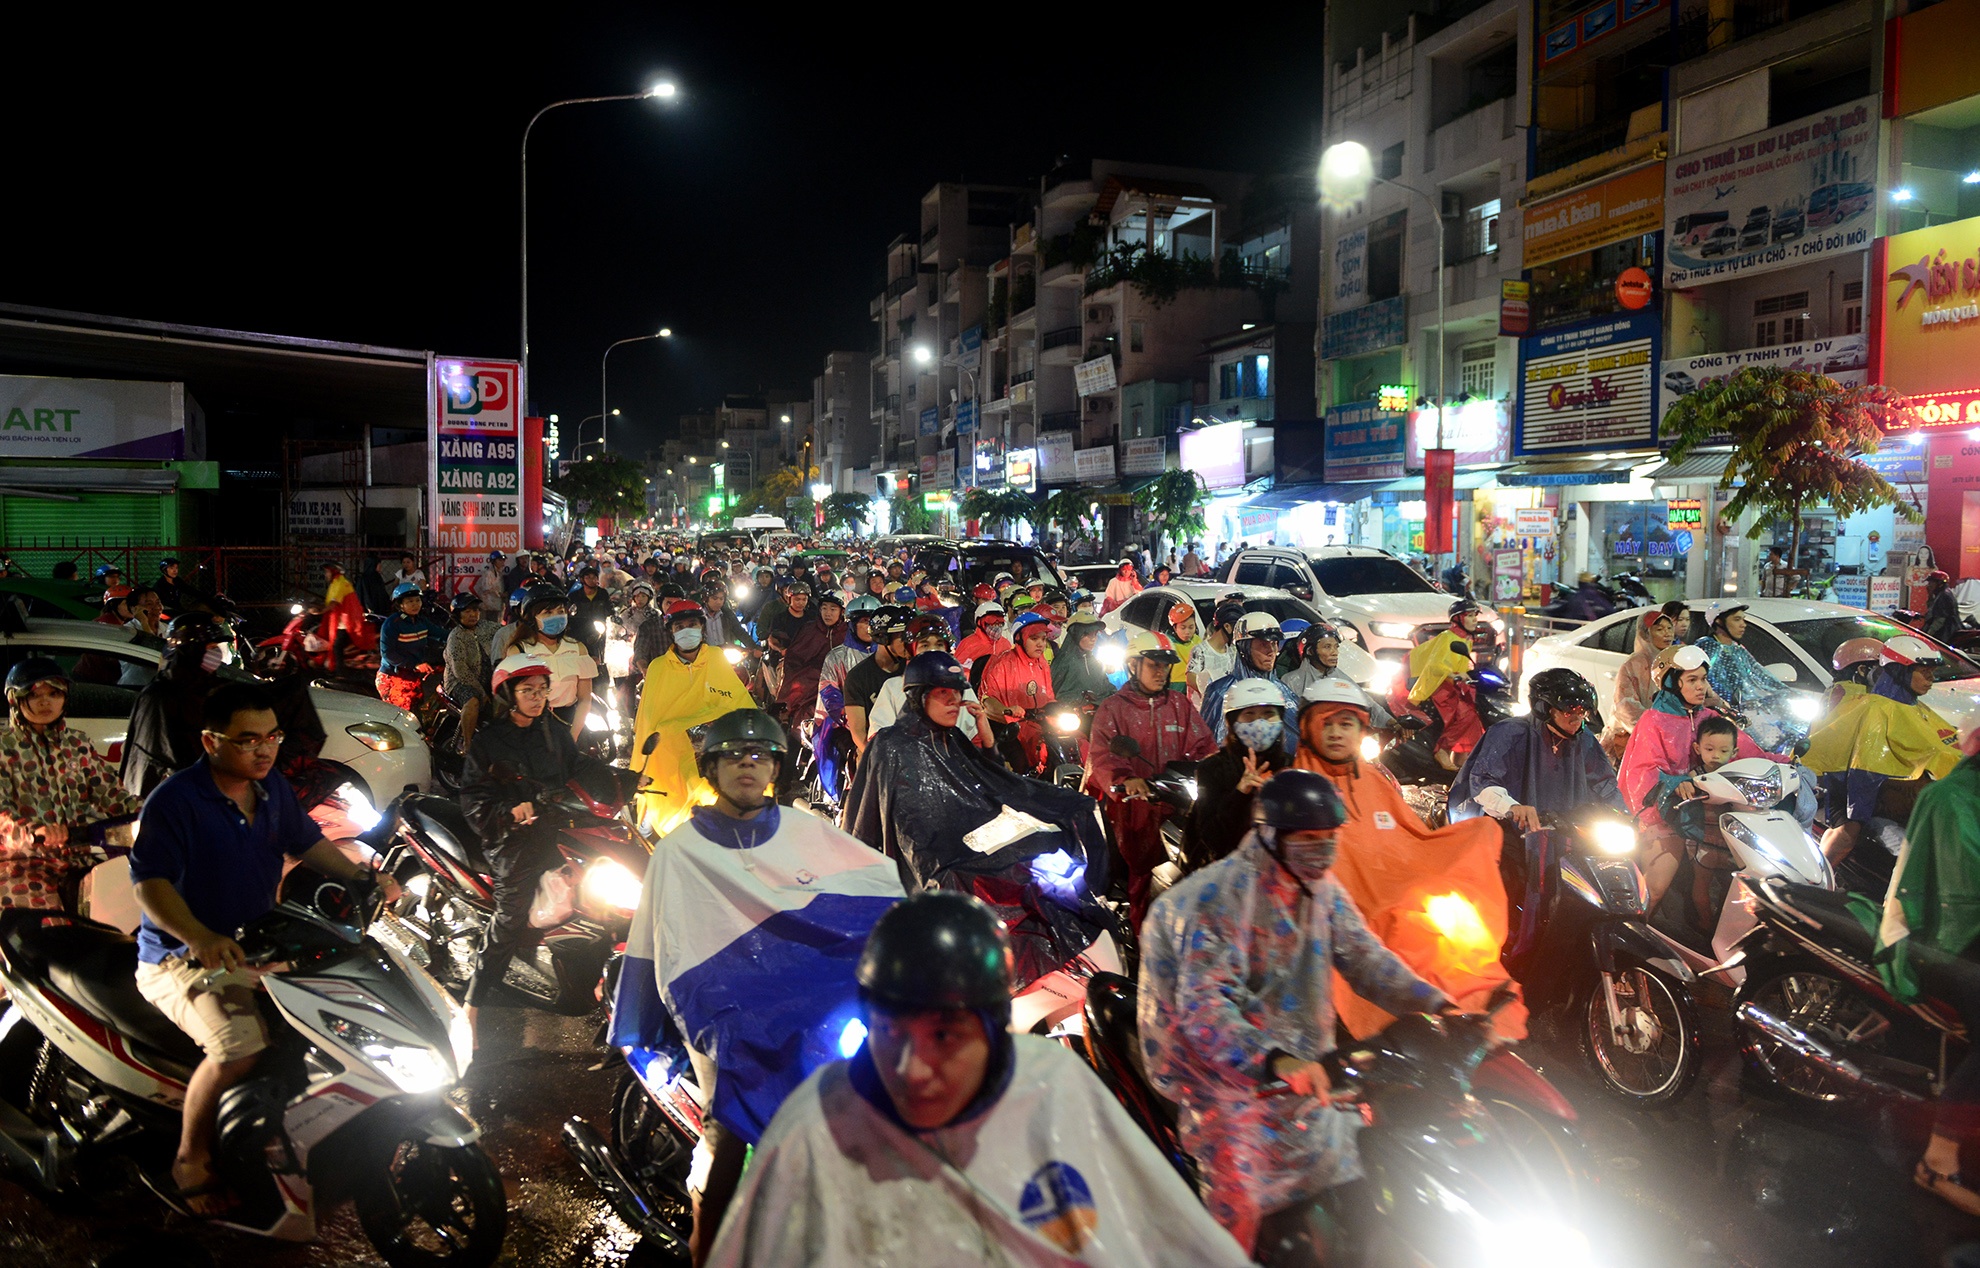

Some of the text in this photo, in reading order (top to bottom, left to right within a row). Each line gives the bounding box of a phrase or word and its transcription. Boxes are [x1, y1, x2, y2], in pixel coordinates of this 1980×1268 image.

[1675, 160, 1700, 179] CHO
[1703, 147, 1736, 172] THUÊ
[1738, 142, 1755, 162] XE
[1758, 137, 1776, 156] DU
[1779, 127, 1810, 152] LỊCH
[1713, 260, 1725, 274] XE
[1757, 252, 1764, 264] 4
[1794, 245, 1800, 257] 7
[1825, 232, 1844, 250] ĐỜI
[1846, 228, 1867, 246] MỚI
[1922, 306, 1951, 325] MÓN
[1690, 356, 1722, 369] CÔNG
[1726, 354, 1741, 365] TY
[1747, 349, 1780, 362] TNHH
[1784, 345, 1802, 358] TM
[1814, 341, 1833, 353] DV
[441, 438, 516, 460] XĂNG A95
[441, 468, 516, 489] XĂNG A92
[1557, 475, 1585, 484] GIANG
[309, 502, 319, 515] XE
[441, 499, 517, 521] XĂNG SINH HỌC E5
[1669, 508, 1701, 522] MÁY BAY
[440, 526, 517, 549] DẦU DO 0.05S
[1615, 538, 1676, 556] MÁY BAY
[457, 556, 470, 564] GIỜ
[1041, 985, 1068, 1000] HONDA
